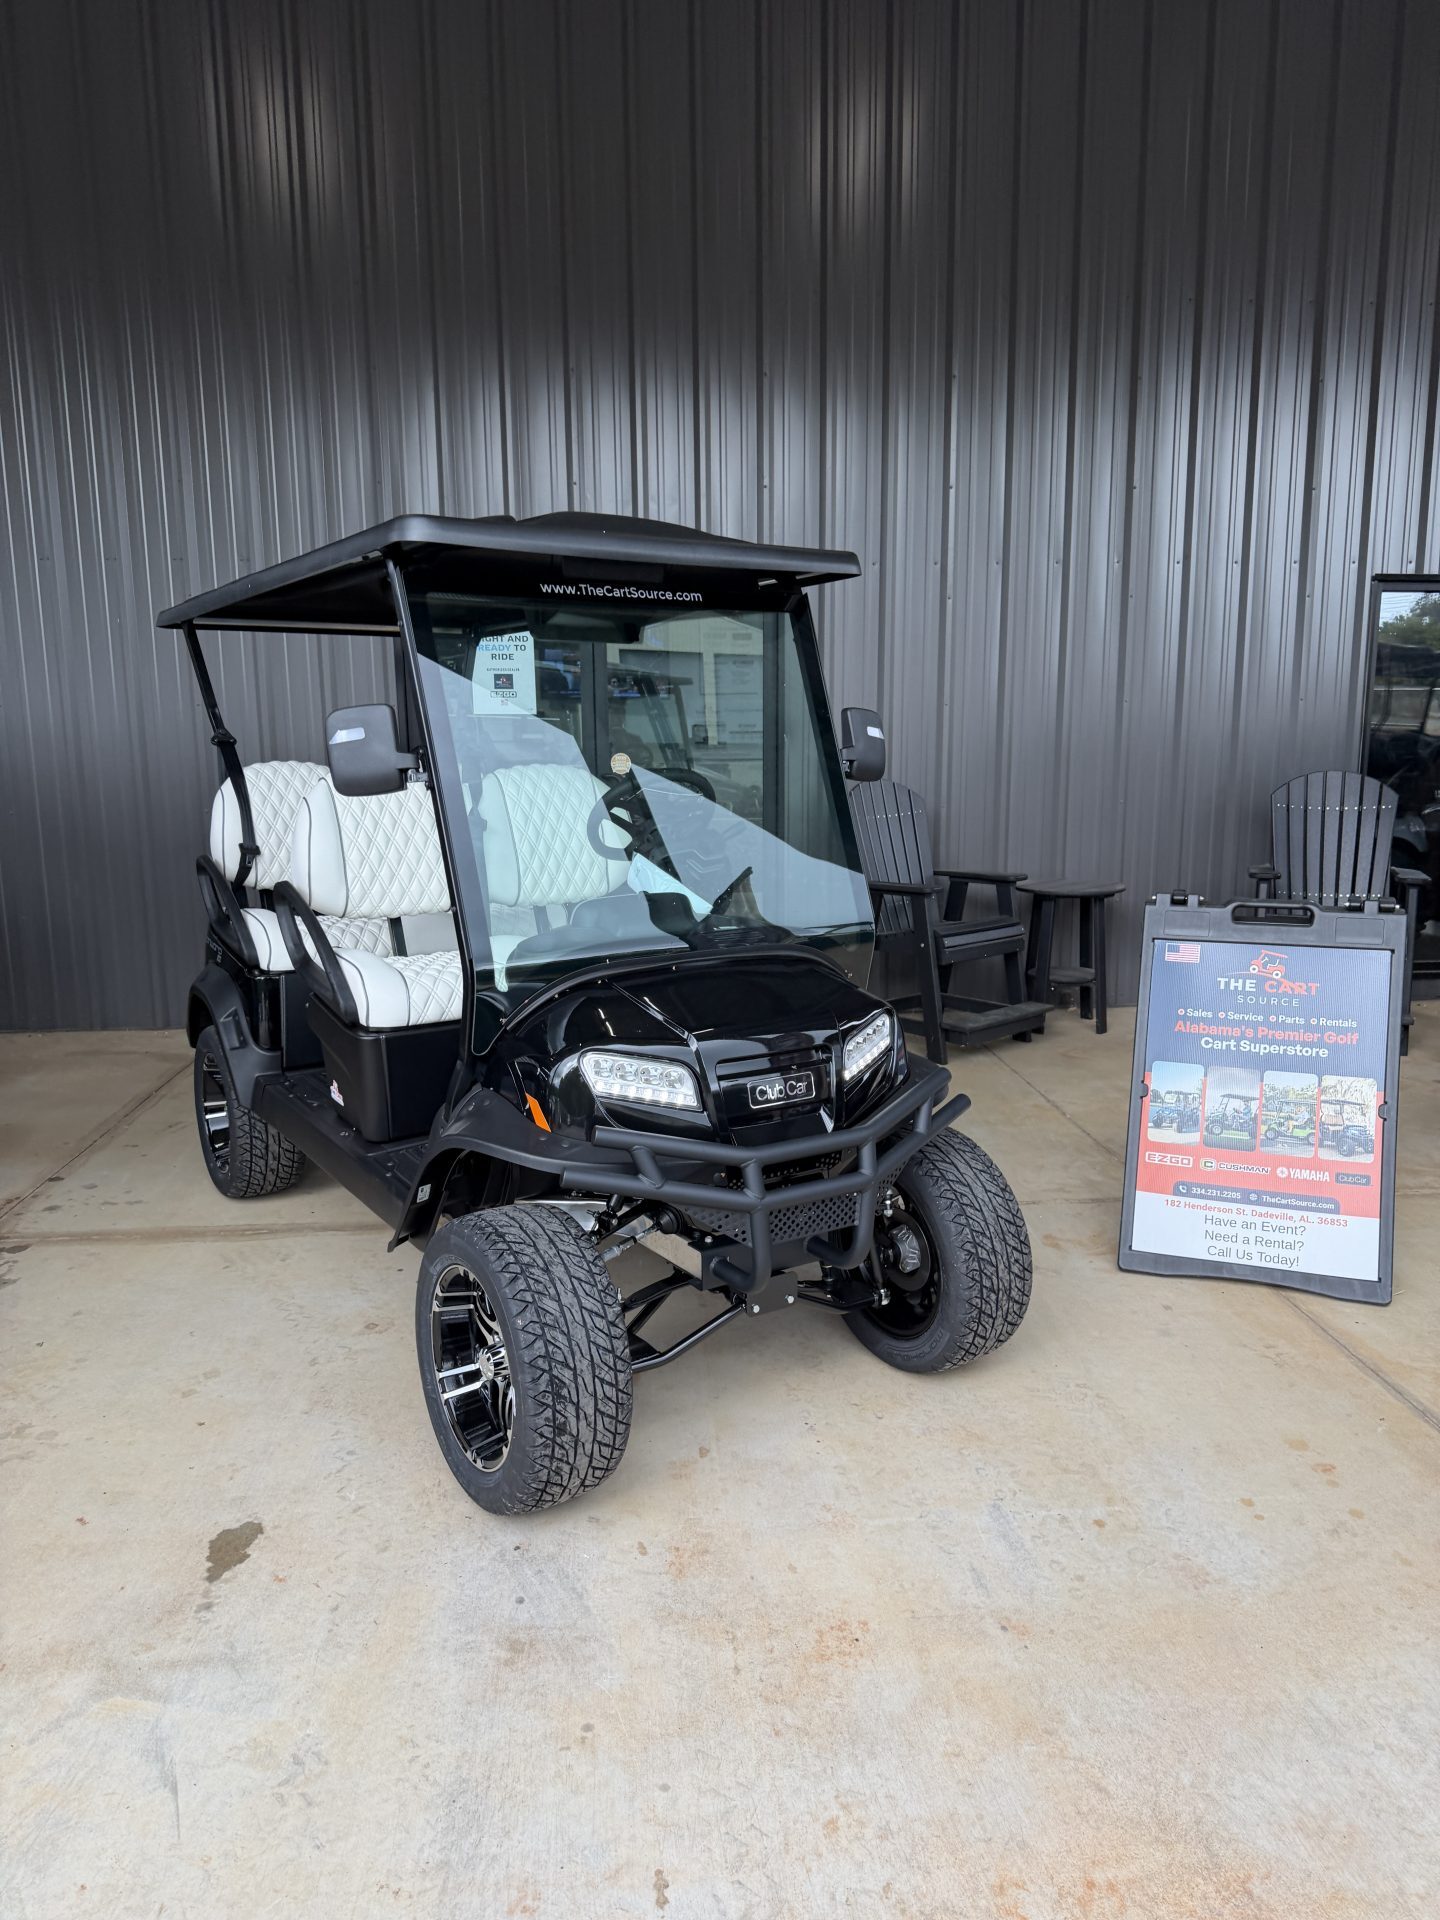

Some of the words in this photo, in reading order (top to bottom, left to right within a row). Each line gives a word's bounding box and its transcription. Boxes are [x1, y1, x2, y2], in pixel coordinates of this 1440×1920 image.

[539, 583, 703, 602] www.TheCartSource.com
[478, 644, 511, 652] READY
[513, 644, 526, 652] TO
[480, 635, 505, 643] IGHT
[507, 635, 529, 643] AND
[491, 653, 515, 661] RIDE
[1217, 977, 1257, 992] THE
[1264, 980, 1320, 996] CART
[1237, 995, 1300, 1007] SOURCE
[1186, 1008, 1213, 1018] Sales
[1227, 1011, 1264, 1023] Service
[1278, 1015, 1305, 1026] Parts
[1319, 1017, 1358, 1029] Rentals
[1174, 1020, 1254, 1039] Alabama's
[1257, 1026, 1321, 1042] Premier
[1323, 1031, 1359, 1045] Golf
[1200, 1036, 1237, 1052] Cart
[1239, 1039, 1329, 1057] Superstore
[756, 1083, 785, 1101] Club
[786, 1080, 808, 1096] Car
[1147, 1153, 1192, 1166] EZGO
[1219, 1162, 1270, 1175] CUSHMAN
[1289, 1167, 1331, 1182] YAMAHA
[1190, 1186, 1242, 1199] 334.231.2205
[1262, 1194, 1335, 1210] TheCartSource.com
[1164, 1199, 1182, 1208] 182
[1183, 1201, 1234, 1215] Henderson
[1235, 1207, 1249, 1217] St.
[1251, 1209, 1297, 1223] Dadeville,
[1299, 1215, 1316, 1225] AL.
[1317, 1216, 1349, 1228] 36853
[1204, 1214, 1238, 1228] Have
[1241, 1220, 1257, 1231] an
[1261, 1221, 1307, 1236] Event?
[1204, 1229, 1239, 1244] Need
[1242, 1235, 1250, 1245] a
[1254, 1235, 1305, 1252] Rental?
[1207, 1245, 1232, 1258] Call
[1236, 1248, 1254, 1261] Us
[1257, 1251, 1300, 1269] Today!
